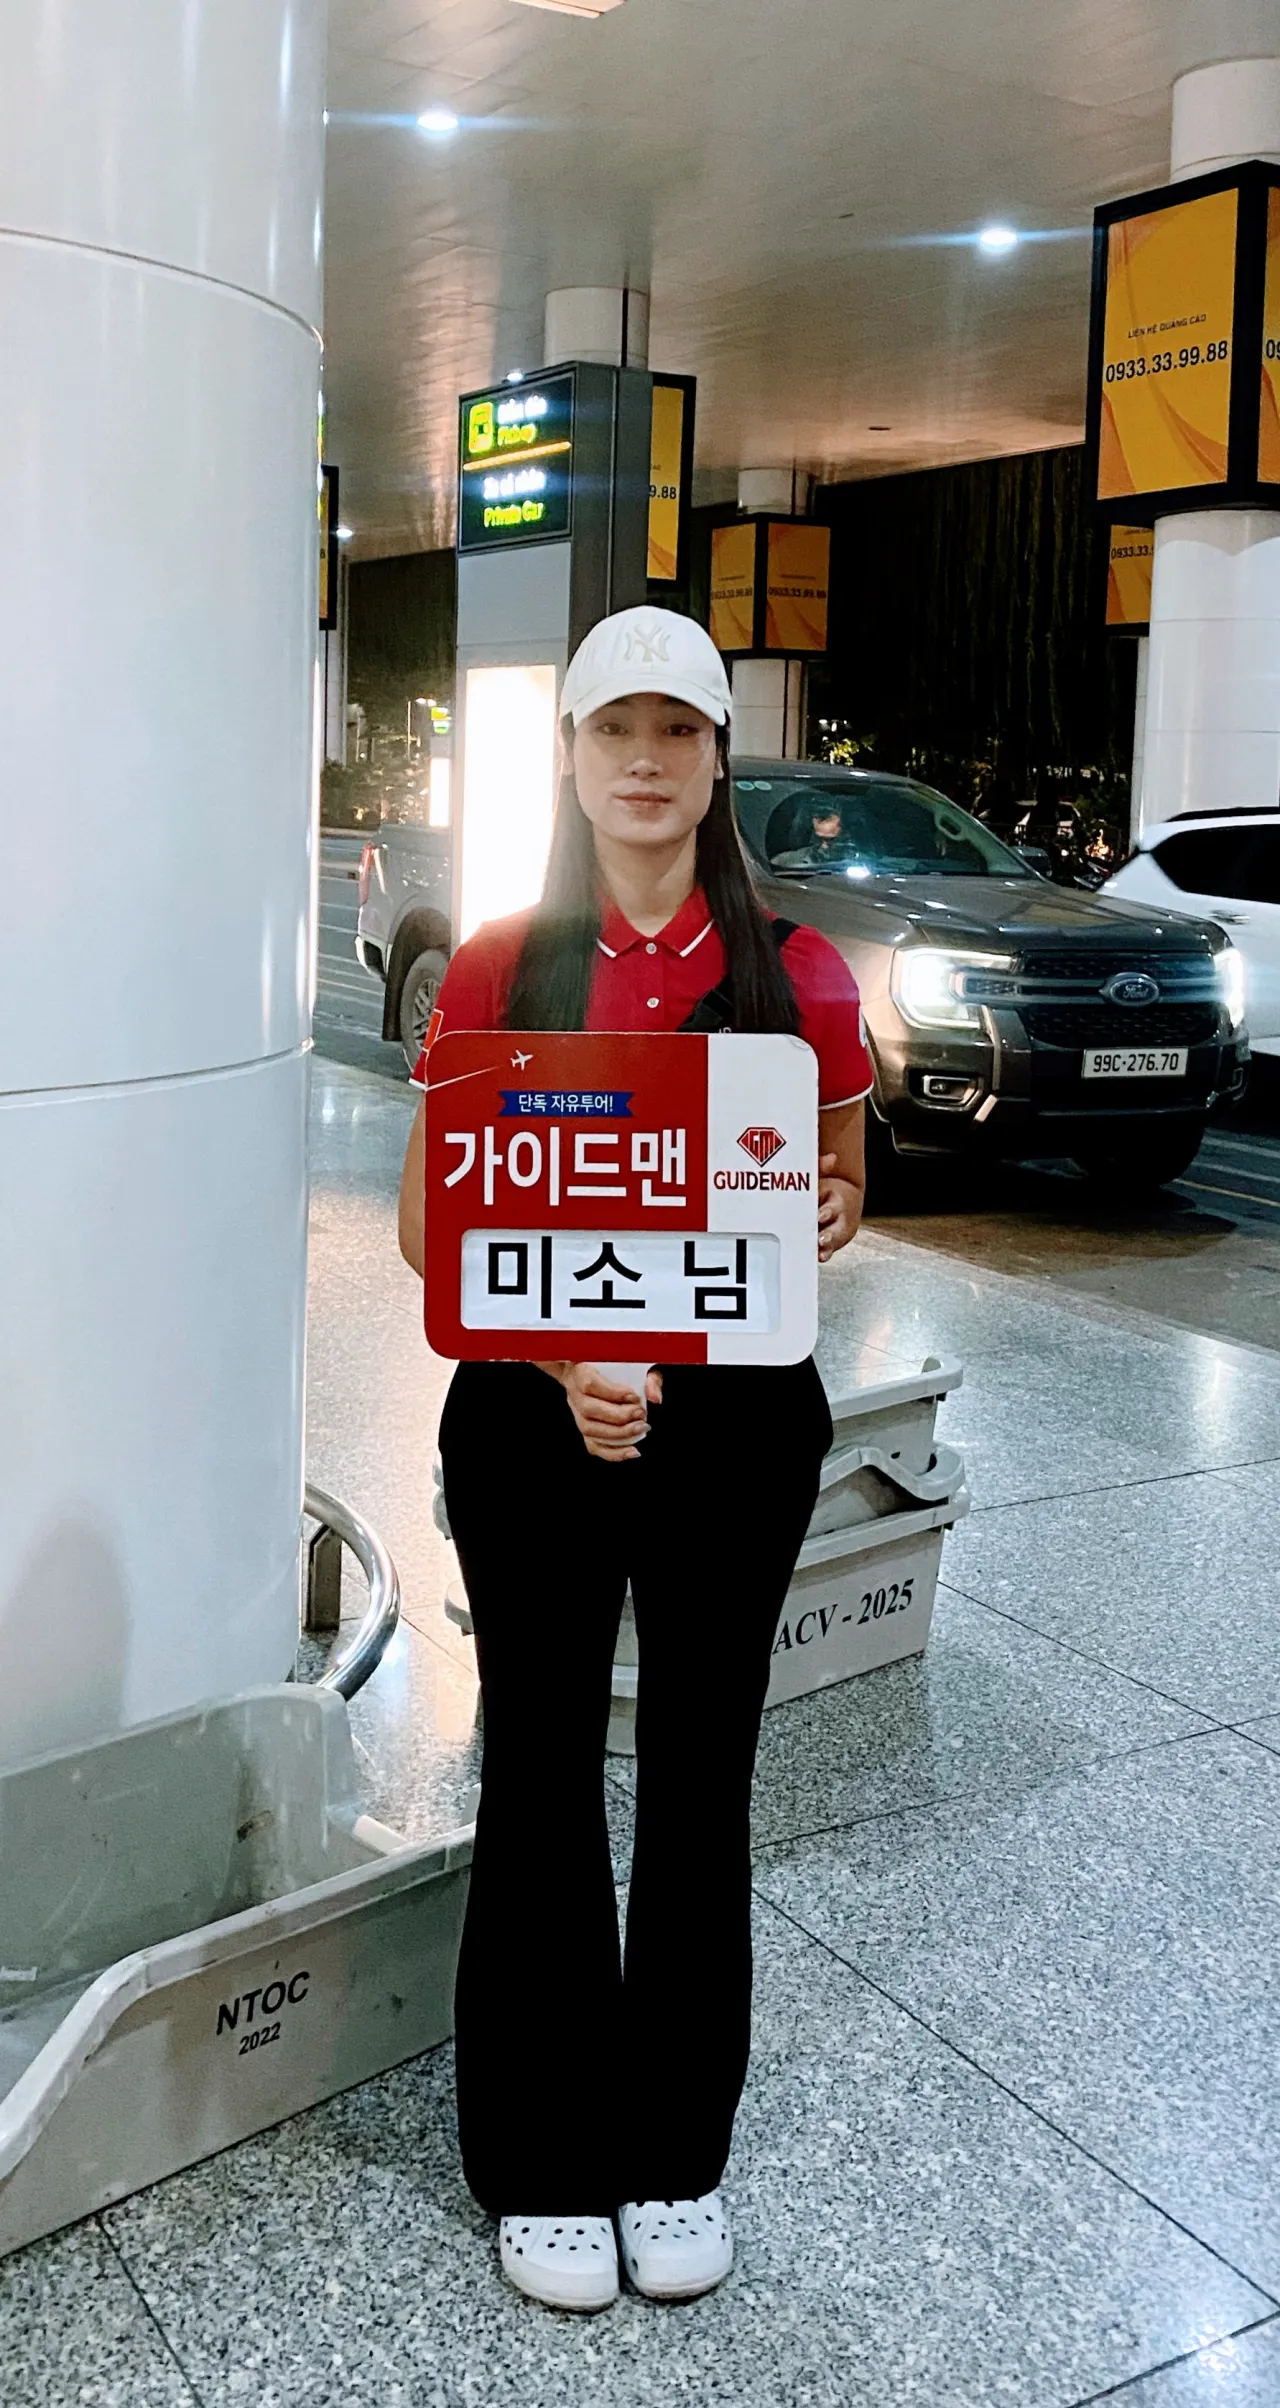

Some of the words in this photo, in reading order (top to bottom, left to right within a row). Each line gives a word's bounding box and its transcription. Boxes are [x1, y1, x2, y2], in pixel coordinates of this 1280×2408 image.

[1106, 340, 1228, 383] 0933.33.99.88
[1122, 984, 1149, 999] Ford
[519, 1094, 547, 1113] 단독
[551, 1094, 613, 1113] 자유투어!
[444, 1126, 687, 1207] 가이드맨
[713, 1170, 810, 1192] GUIDEMAN
[487, 1235, 646, 1320] 미소
[684, 1238, 748, 1321] 님
[772, 1603, 839, 1655] ACV
[857, 1578, 915, 1626] 2025
[216, 1971, 310, 2036] NTOC
[238, 2021, 282, 2056] 2022
